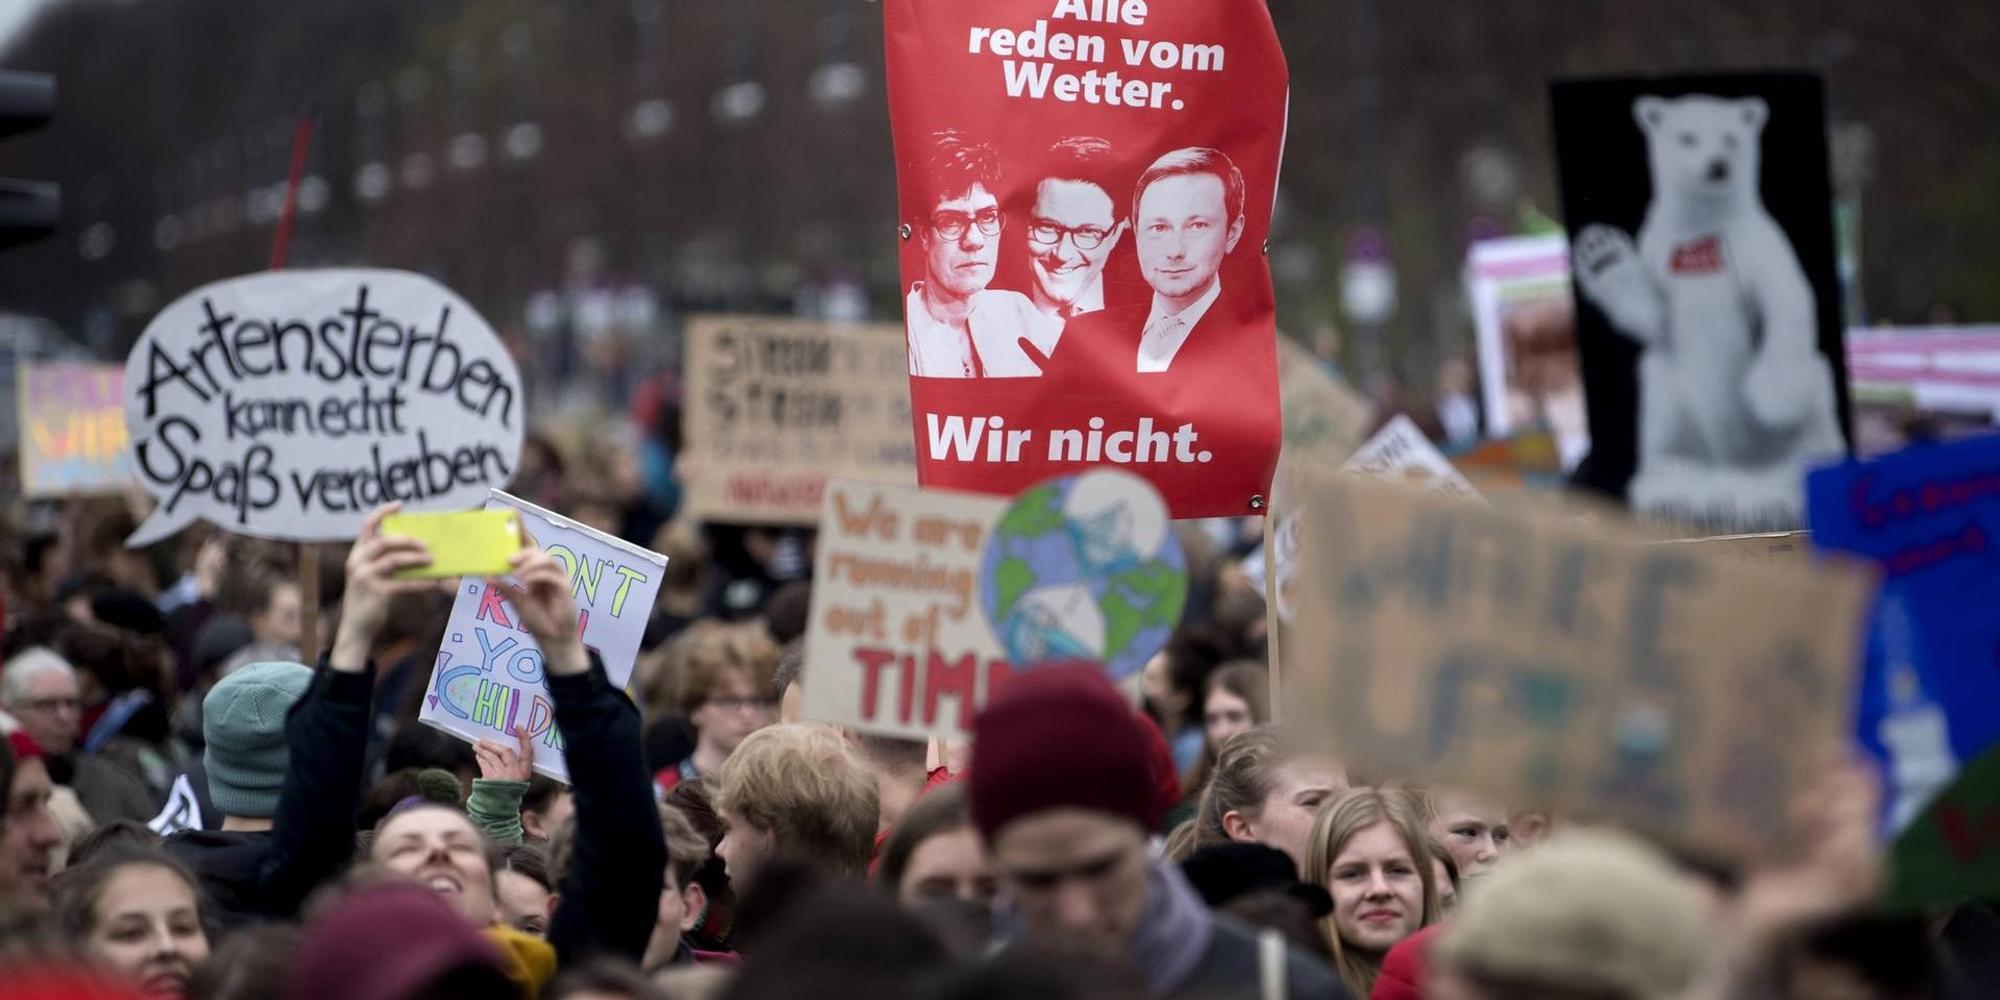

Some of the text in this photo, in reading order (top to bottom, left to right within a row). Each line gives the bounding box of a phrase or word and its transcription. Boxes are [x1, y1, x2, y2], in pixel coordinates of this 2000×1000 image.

[968, 19, 1225, 71] reden vom
[1002, 60, 1184, 111] Wetter.
[136, 284, 514, 427] Artensterben
[224, 383, 406, 441] kann echt
[926, 412, 1032, 462] Wir
[1047, 416, 1213, 463] nicht.
[135, 415, 511, 524] Spaß verderben
[834, 491, 984, 553] We are
[525, 533, 648, 618] ON'T
[829, 551, 974, 623] running
[824, 597, 942, 650] out of
